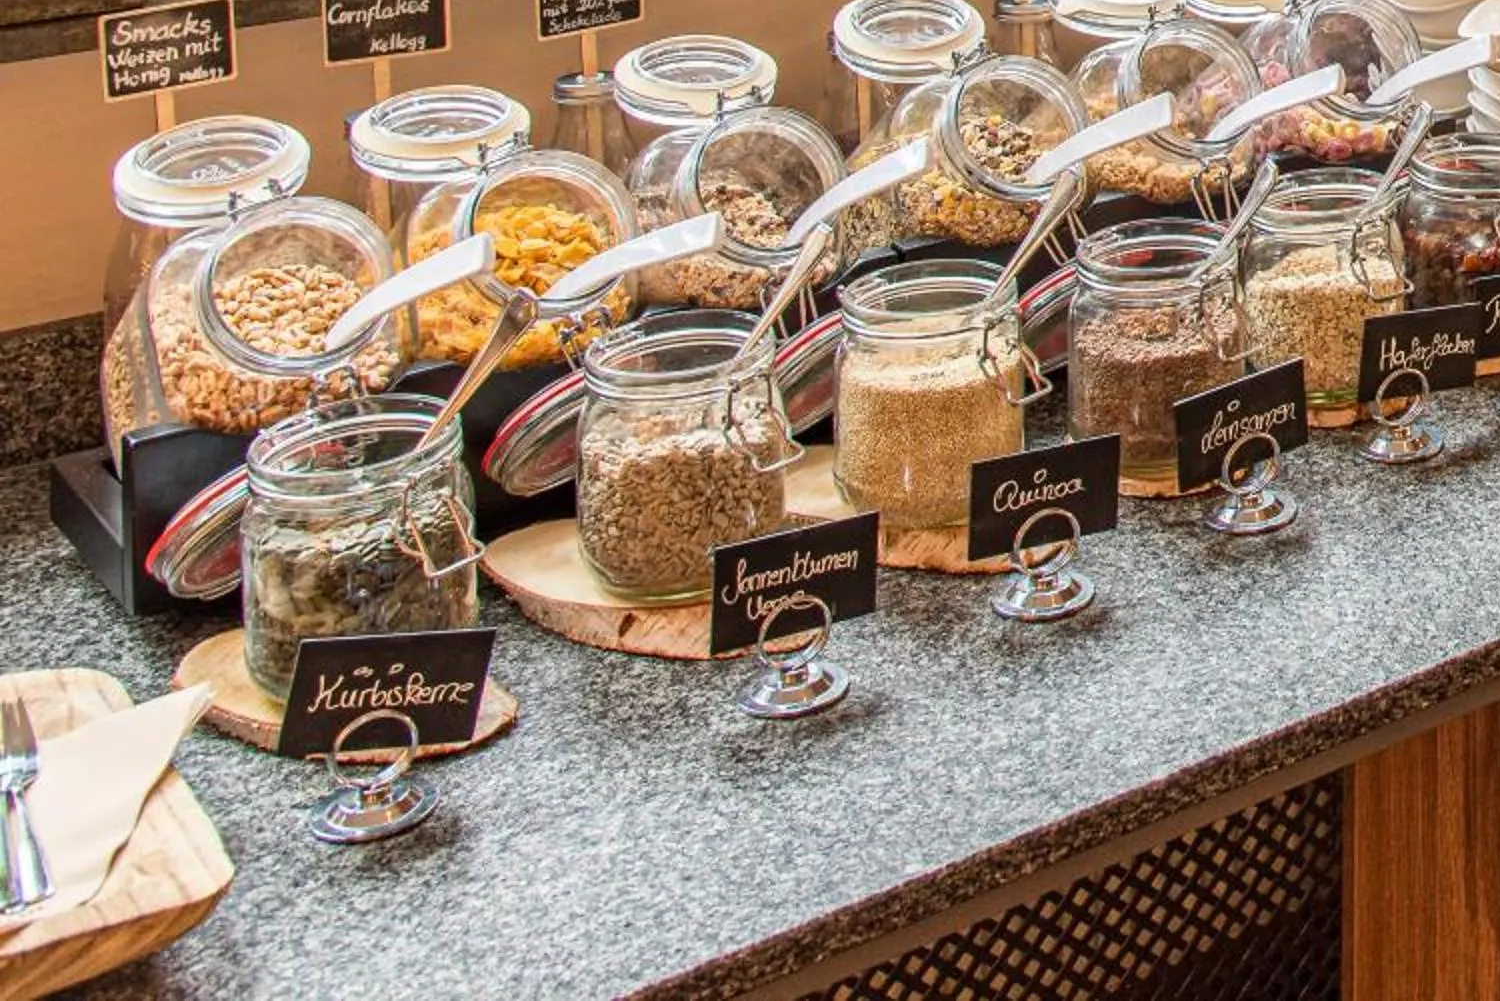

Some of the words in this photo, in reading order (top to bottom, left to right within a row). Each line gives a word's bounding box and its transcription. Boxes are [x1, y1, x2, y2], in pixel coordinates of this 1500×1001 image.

[112, 11, 212, 46] Smacks
[108, 46, 179, 70] Weizen
[185, 31, 224, 56] mit
[114, 64, 171, 90] Honig
[993, 468, 1086, 512] Quinoa
